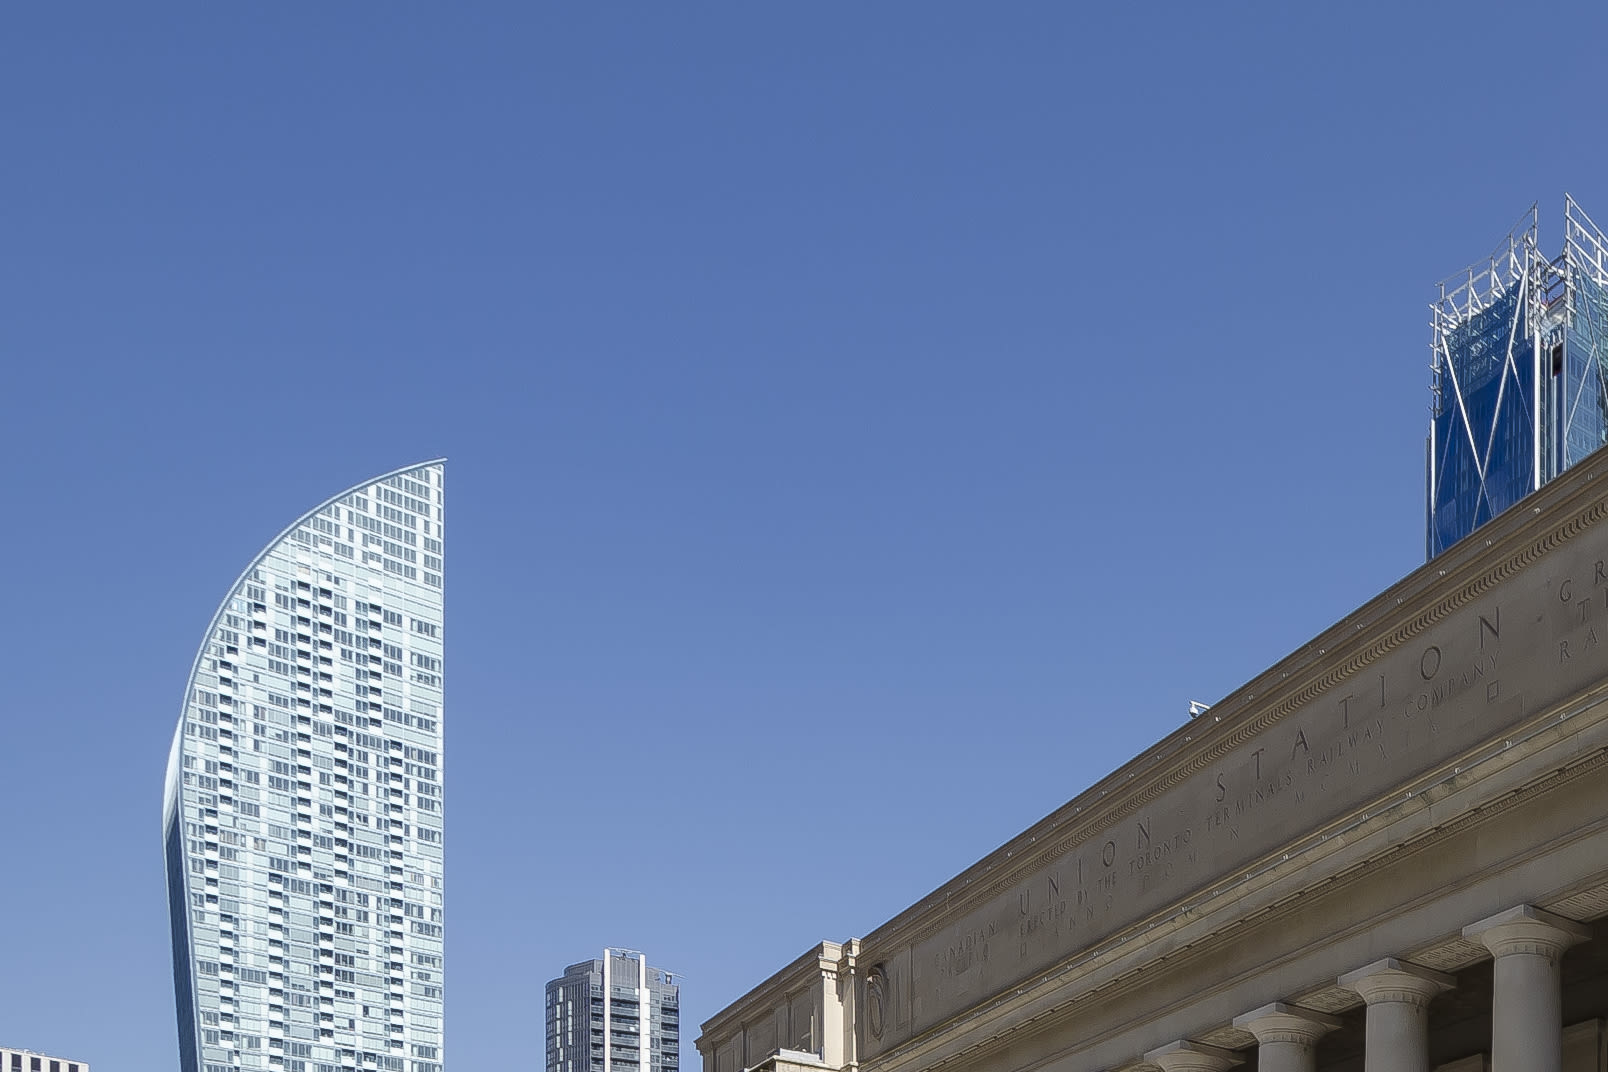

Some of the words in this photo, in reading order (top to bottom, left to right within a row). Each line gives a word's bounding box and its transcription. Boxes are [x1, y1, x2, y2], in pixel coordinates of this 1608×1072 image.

[1018, 816, 1151, 917] UNION
[1215, 606, 1501, 803] STATION
[1128, 828, 1193, 874] TORONTO
[1205, 773, 1296, 833] TERMINALS
[1305, 719, 1385, 777] RAILWAY
[1404, 649, 1501, 719] COMPANY
